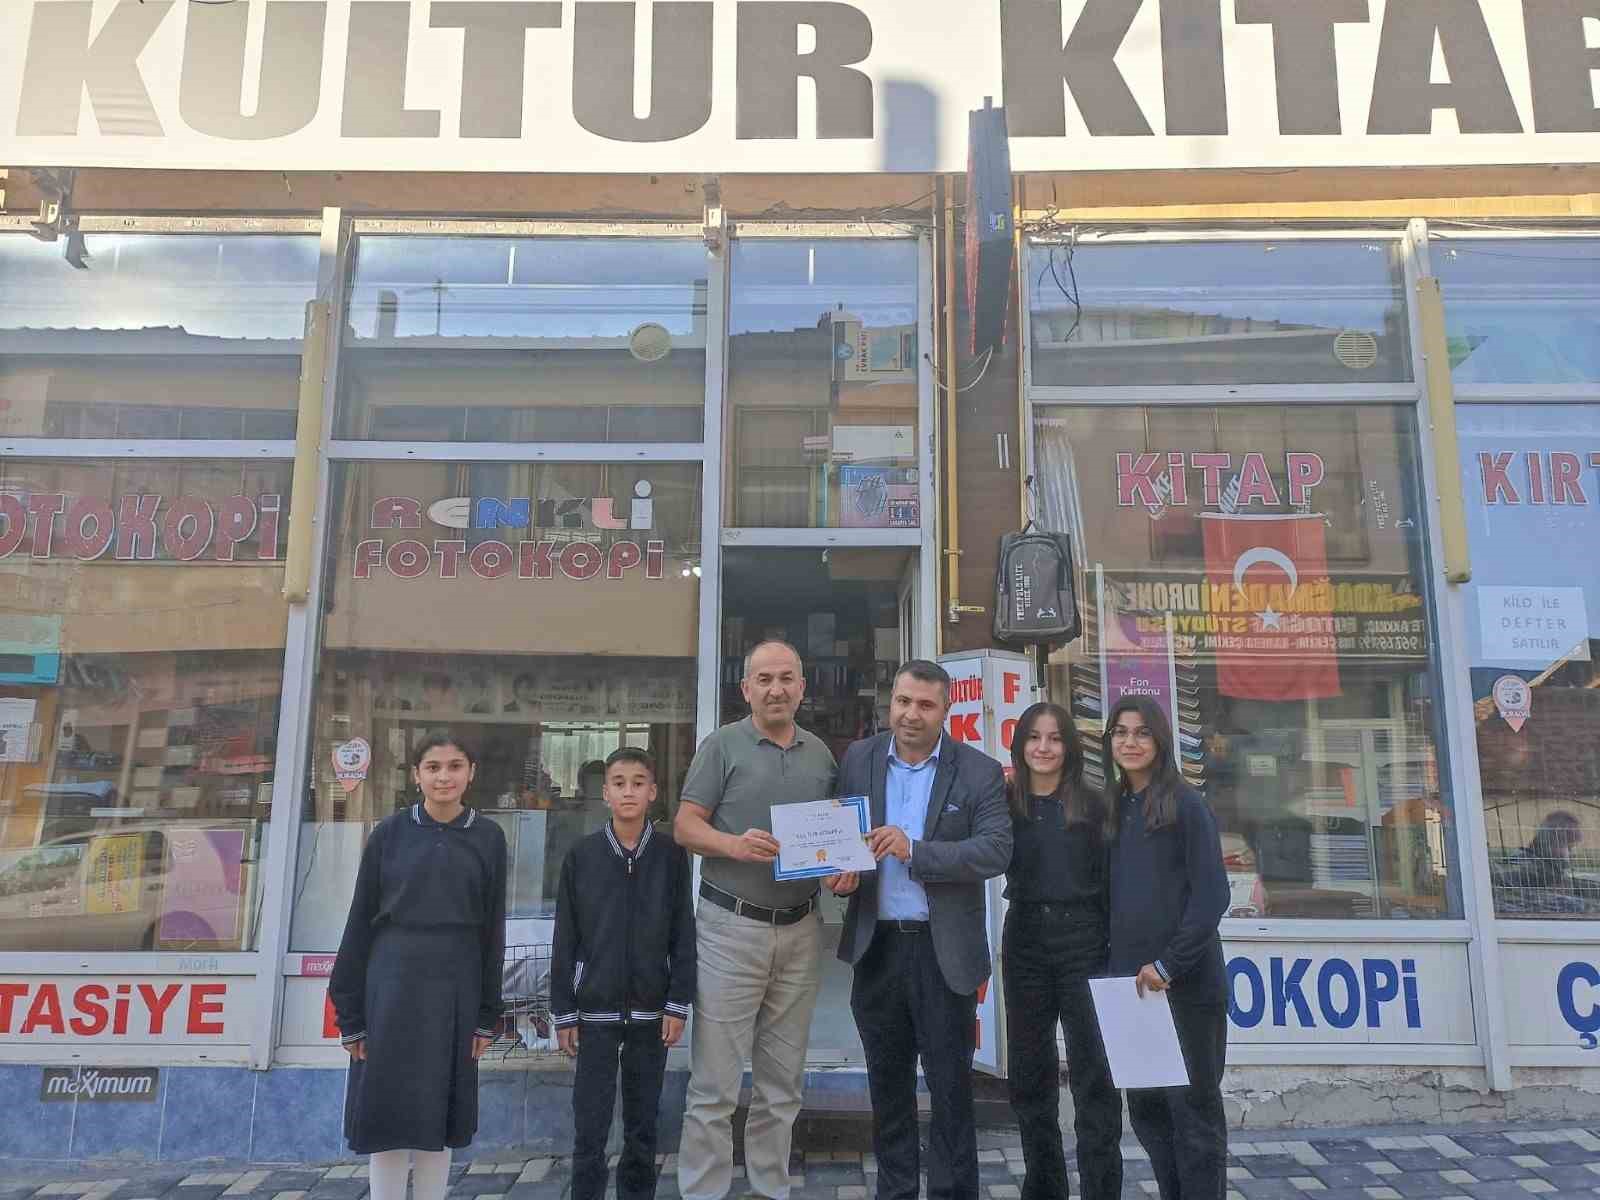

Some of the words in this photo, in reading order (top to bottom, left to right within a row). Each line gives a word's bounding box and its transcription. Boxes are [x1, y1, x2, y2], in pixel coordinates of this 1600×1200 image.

[1479, 450, 1600, 505] KIR
[1501, 616, 1567, 629] DEFTER
[1130, 676, 1149, 686] Fon
[949, 673, 984, 704] ÜLTÜR
[1120, 686, 1161, 696] Kartonu
